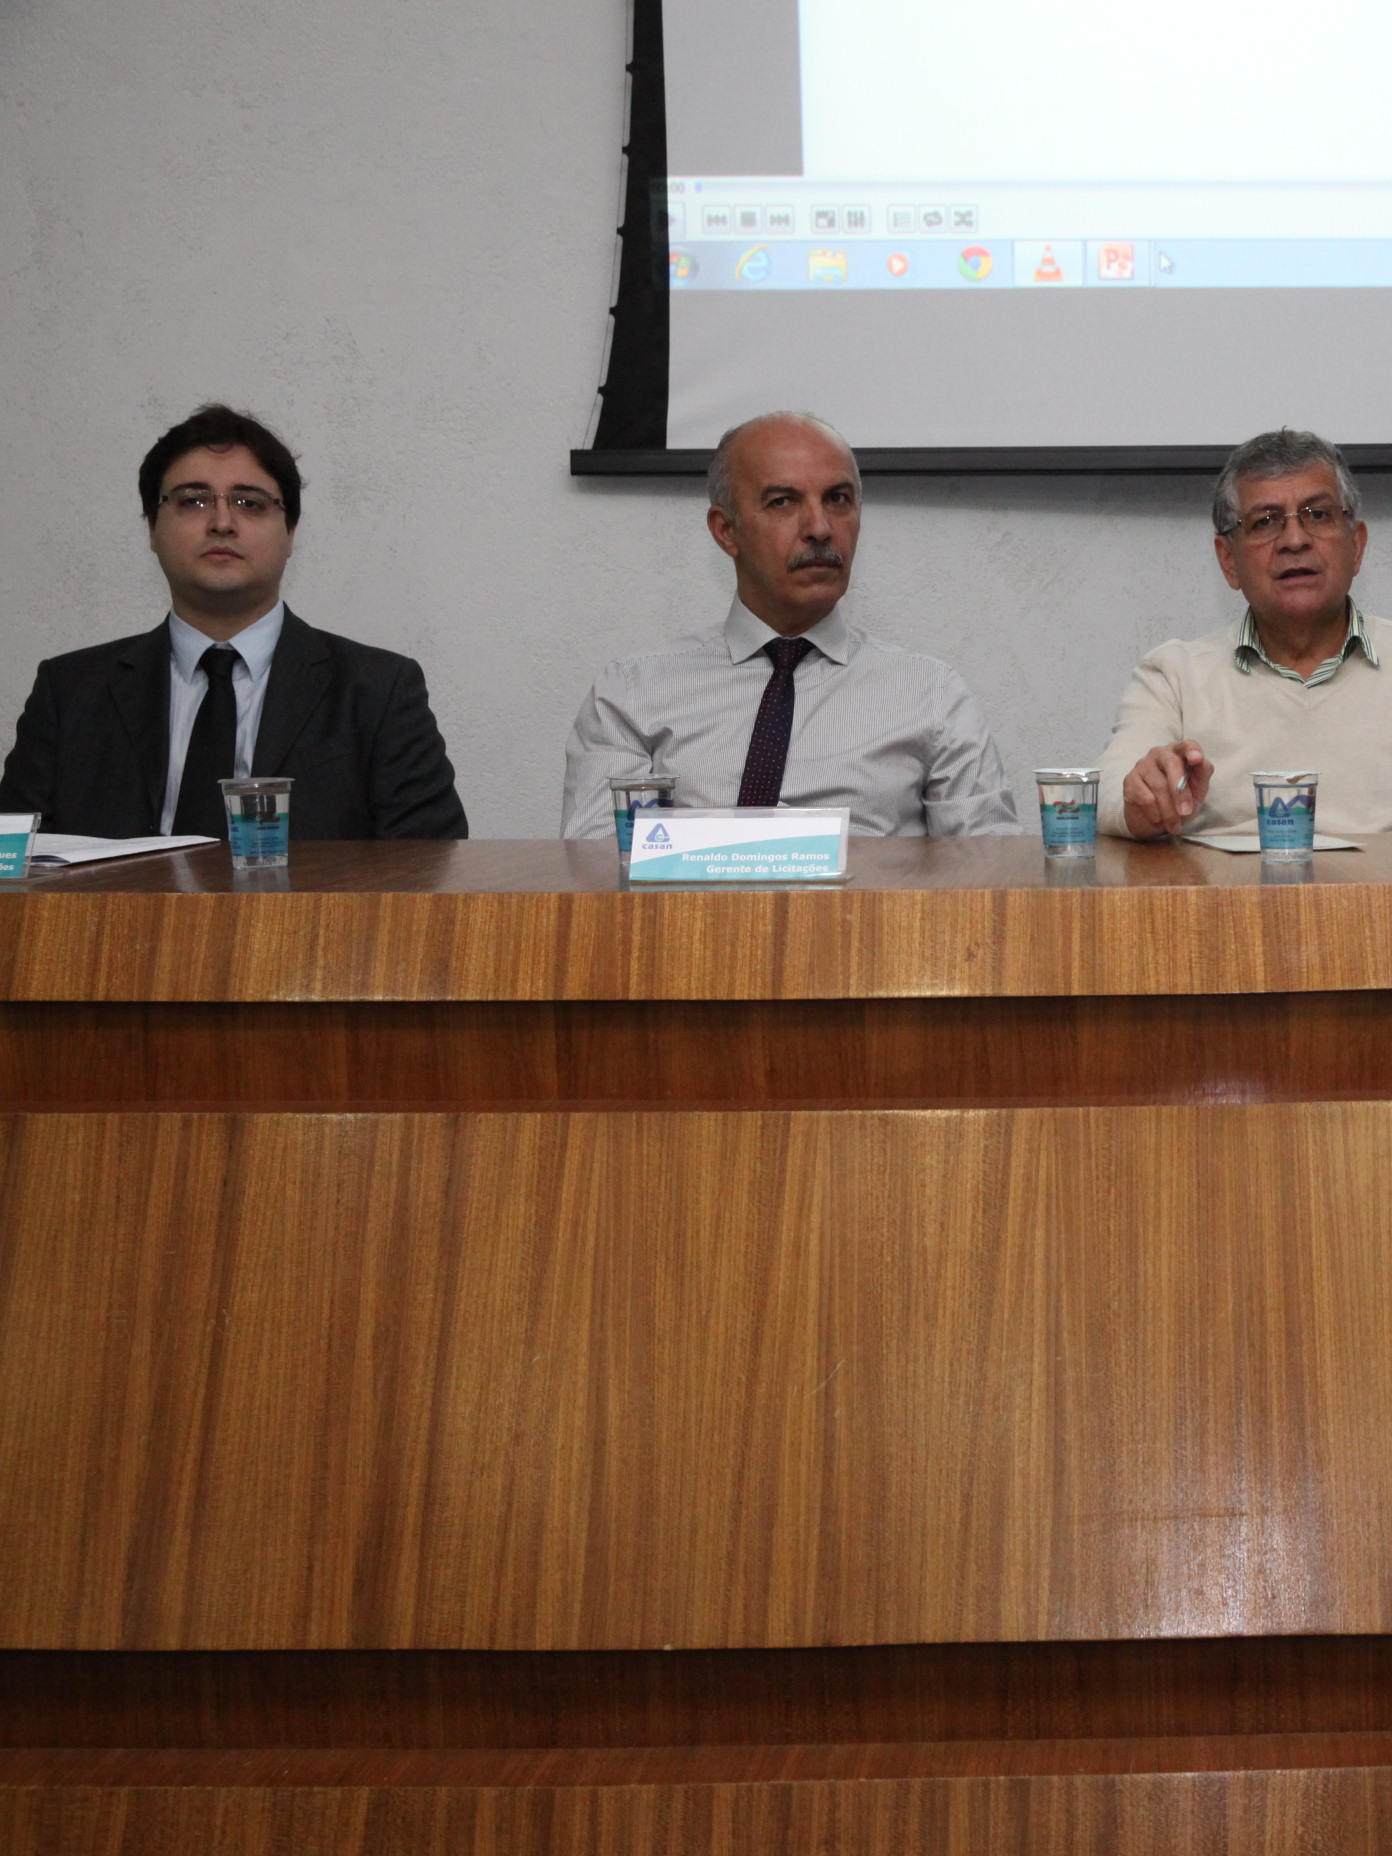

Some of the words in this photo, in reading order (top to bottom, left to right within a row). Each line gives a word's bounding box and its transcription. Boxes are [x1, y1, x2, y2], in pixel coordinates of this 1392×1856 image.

[1266, 818, 1295, 826] casan
[642, 842, 673, 850] casan
[682, 852, 728, 862] Renaldo
[731, 852, 787, 864] Domingos
[792, 852, 830, 861] Ramos
[706, 864, 752, 874] Gerente
[755, 864, 769, 873] de
[772, 863, 829, 875] Licitações
